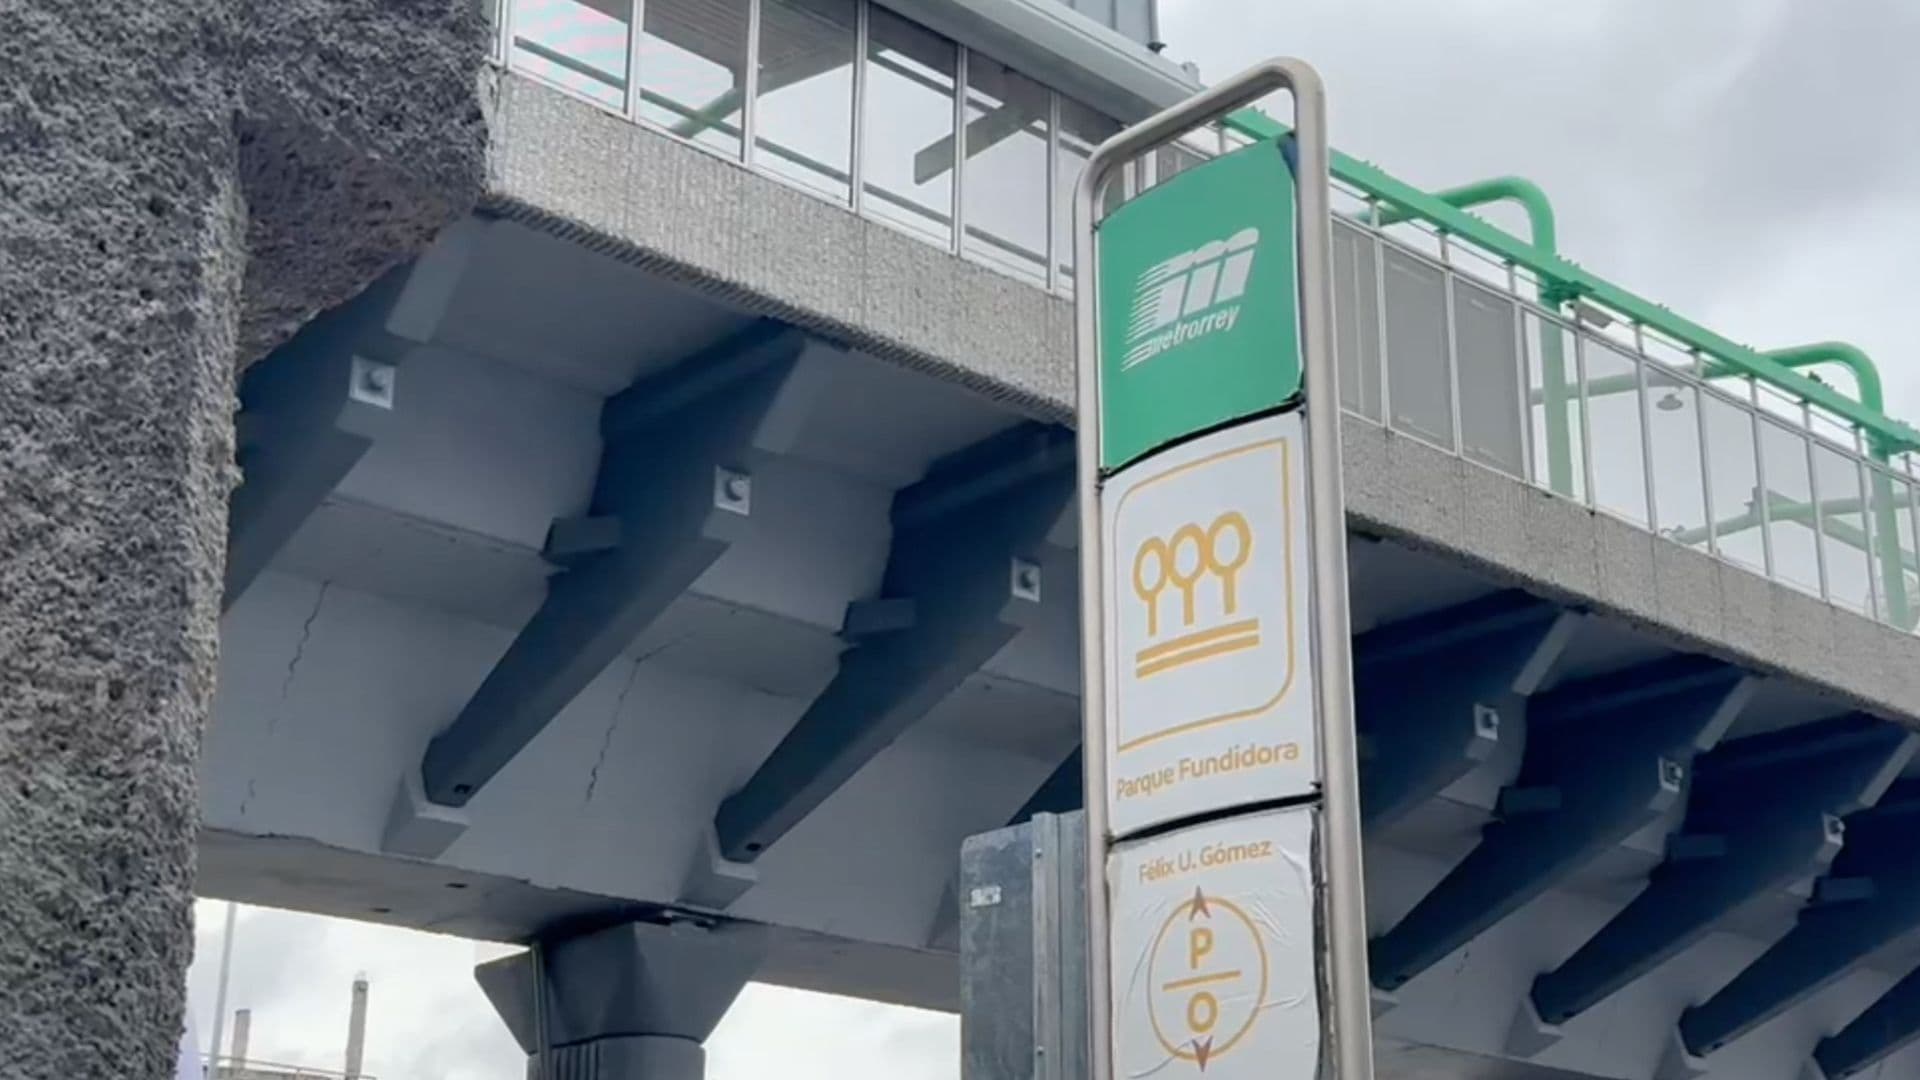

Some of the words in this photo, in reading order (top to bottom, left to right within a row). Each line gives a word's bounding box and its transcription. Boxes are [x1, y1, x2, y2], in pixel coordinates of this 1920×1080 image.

[1138, 304, 1240, 360] metrorrey
[1116, 766, 1174, 800] Parque
[1178, 741, 1299, 780] Fundidora
[1139, 853, 1174, 883] Félix
[1178, 852, 1197, 872] U.
[1200, 838, 1272, 866] Gómez
[1189, 927, 1213, 970] P
[1187, 992, 1218, 1033] O
